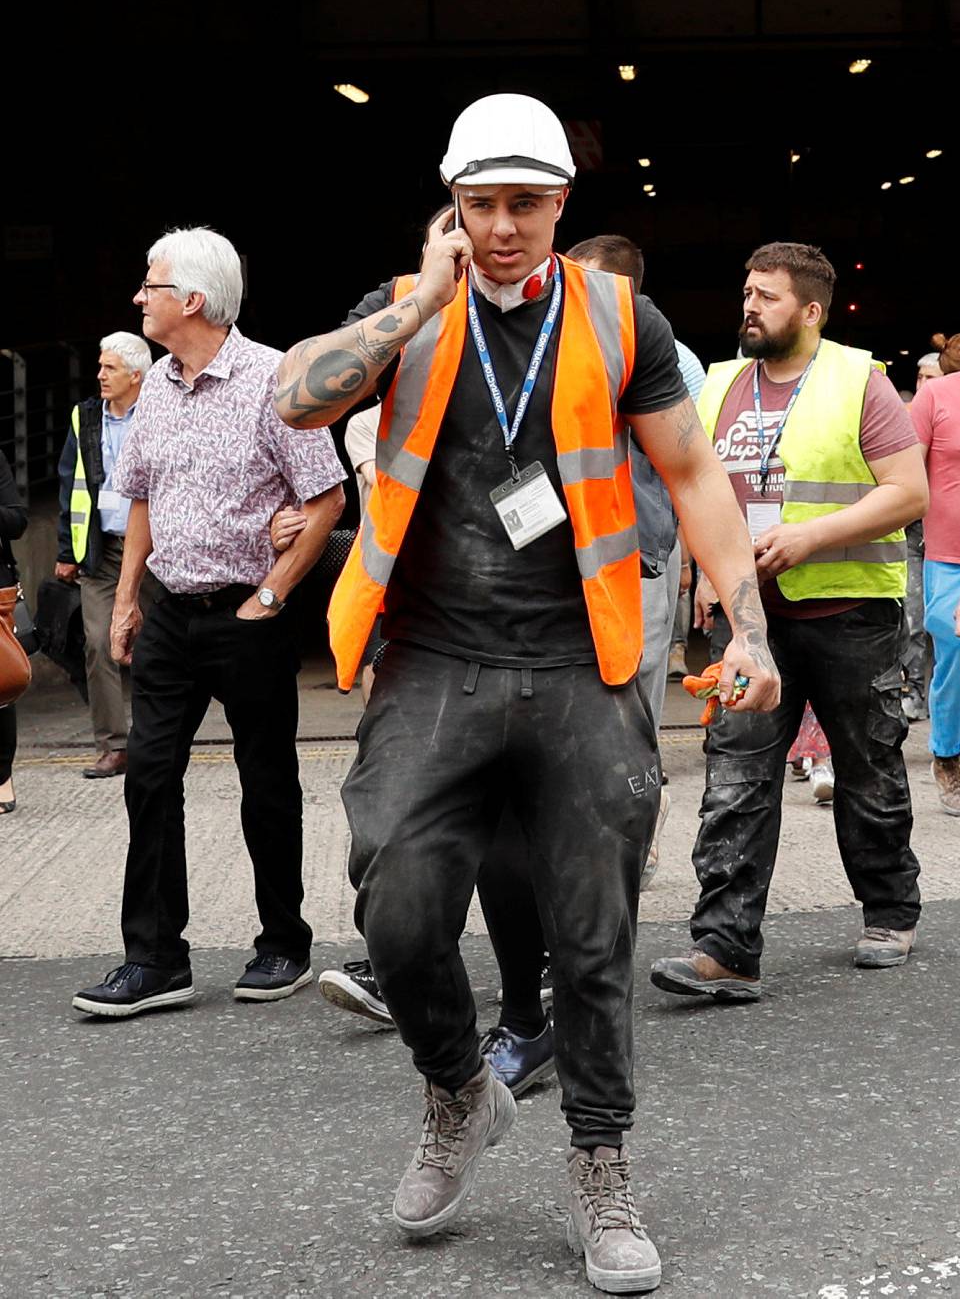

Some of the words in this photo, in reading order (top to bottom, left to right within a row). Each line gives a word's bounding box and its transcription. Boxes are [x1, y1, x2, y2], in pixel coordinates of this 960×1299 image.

[545, 282, 563, 324] CONTRACTOR
[528, 332, 549, 381] CONTRACTOR
[483, 362, 504, 413] CONTRACTOR
[627, 764, 660, 794] EA7
